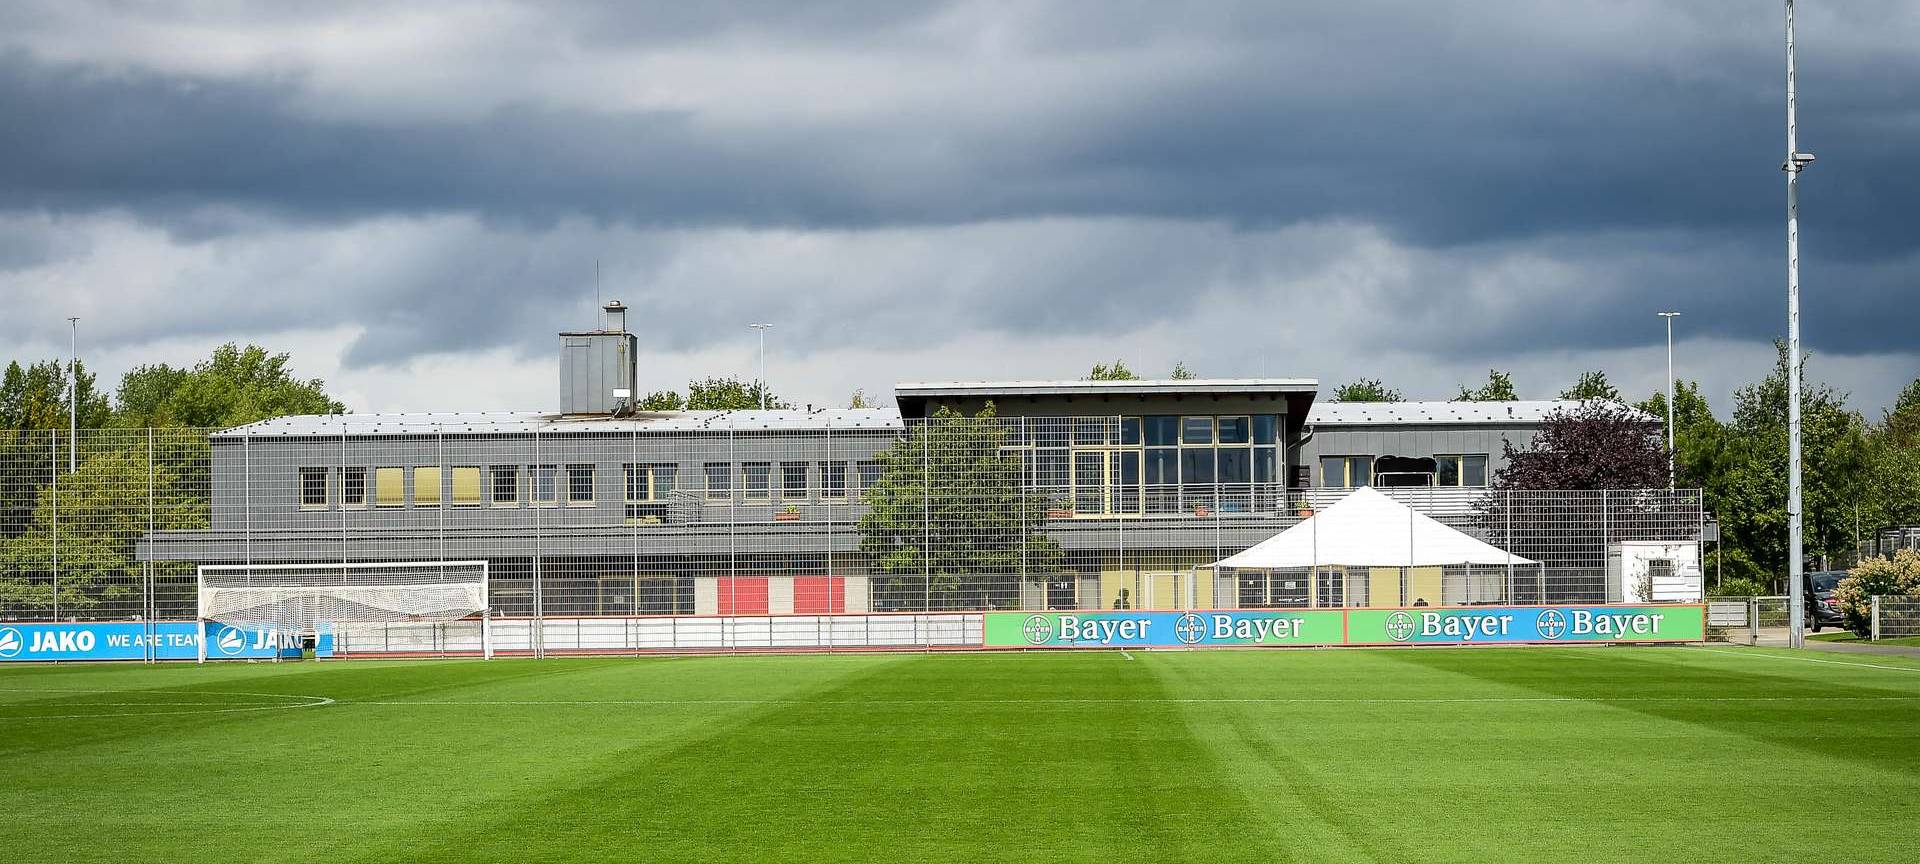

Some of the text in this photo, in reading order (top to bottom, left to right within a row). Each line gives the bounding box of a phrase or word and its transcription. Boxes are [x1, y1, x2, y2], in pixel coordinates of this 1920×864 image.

[1058, 615, 1151, 643] Bayer
[1212, 614, 1305, 641] Bayer
[1421, 612, 1513, 639] Bayer
[1571, 609, 1665, 638] Bayer
[29, 631, 95, 652] JAKO
[106, 634, 130, 647] WE
